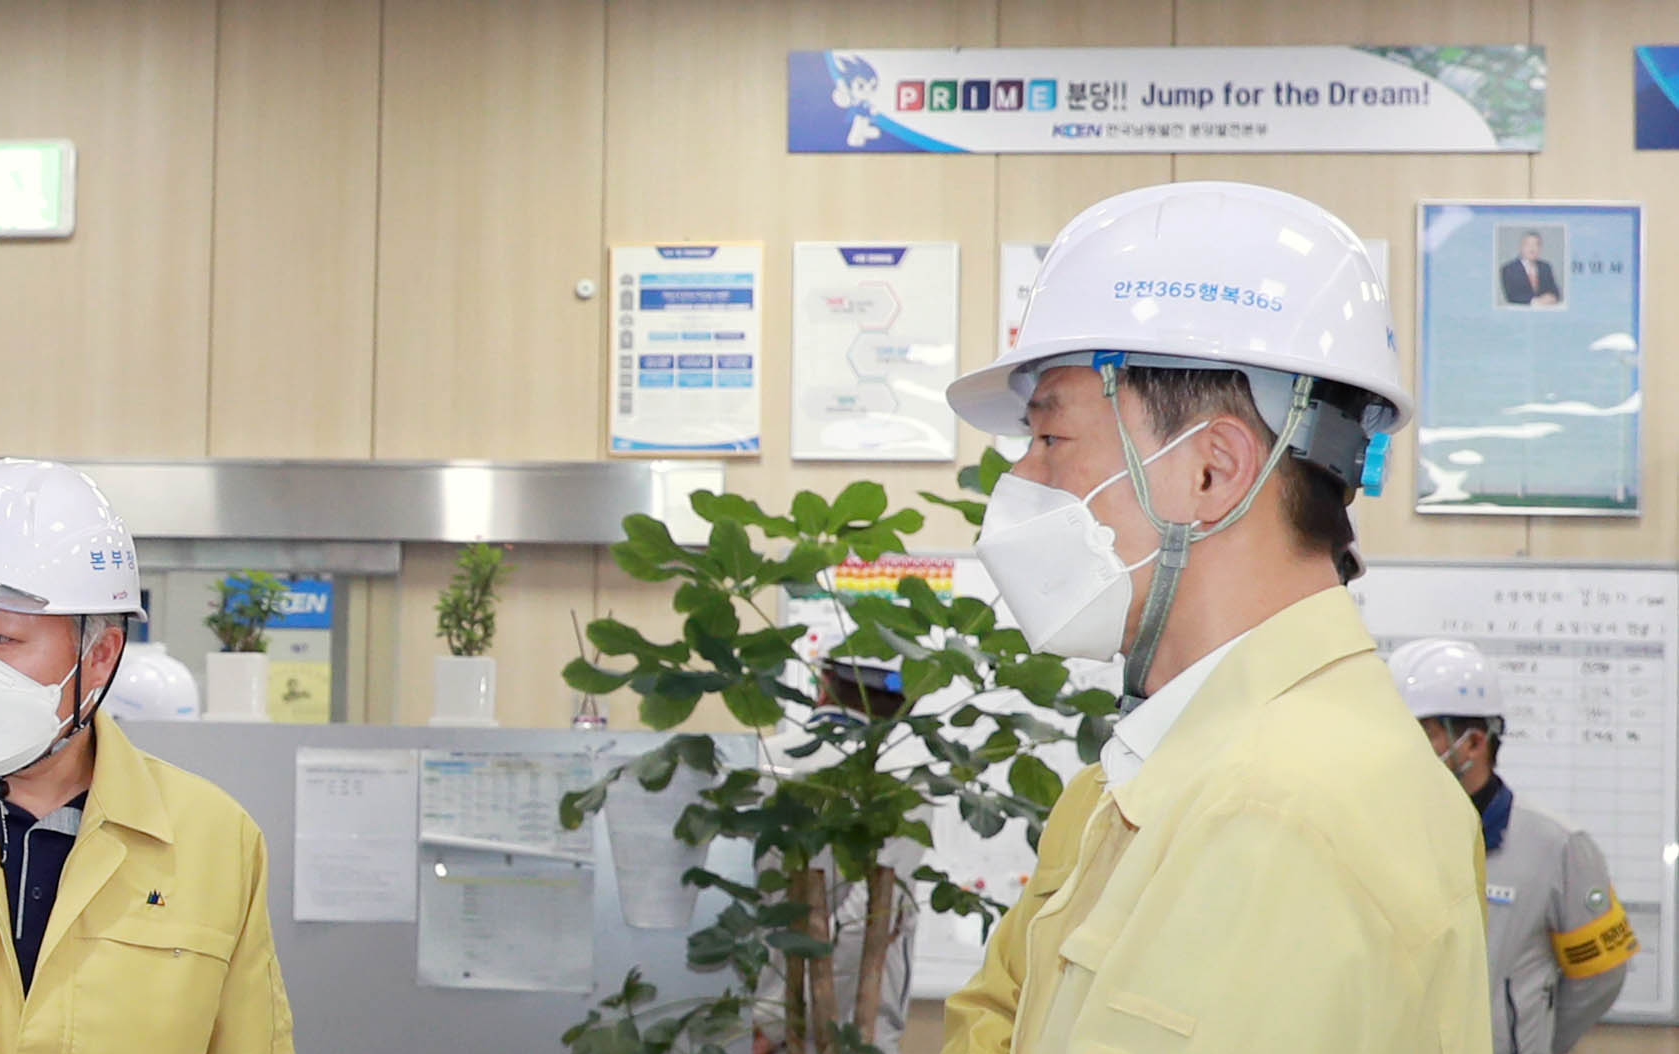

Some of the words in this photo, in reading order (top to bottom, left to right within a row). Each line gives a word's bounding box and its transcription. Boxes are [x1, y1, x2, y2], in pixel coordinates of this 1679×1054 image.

[897, 80, 1057, 111] PRIME
[1066, 80, 1128, 112] 분당!!
[1141, 81, 1214, 110] Jump
[1224, 81, 1265, 108] for
[1274, 81, 1320, 108] the
[1327, 81, 1430, 108] Dream!
[1113, 279, 1284, 313] 안전365행복365
